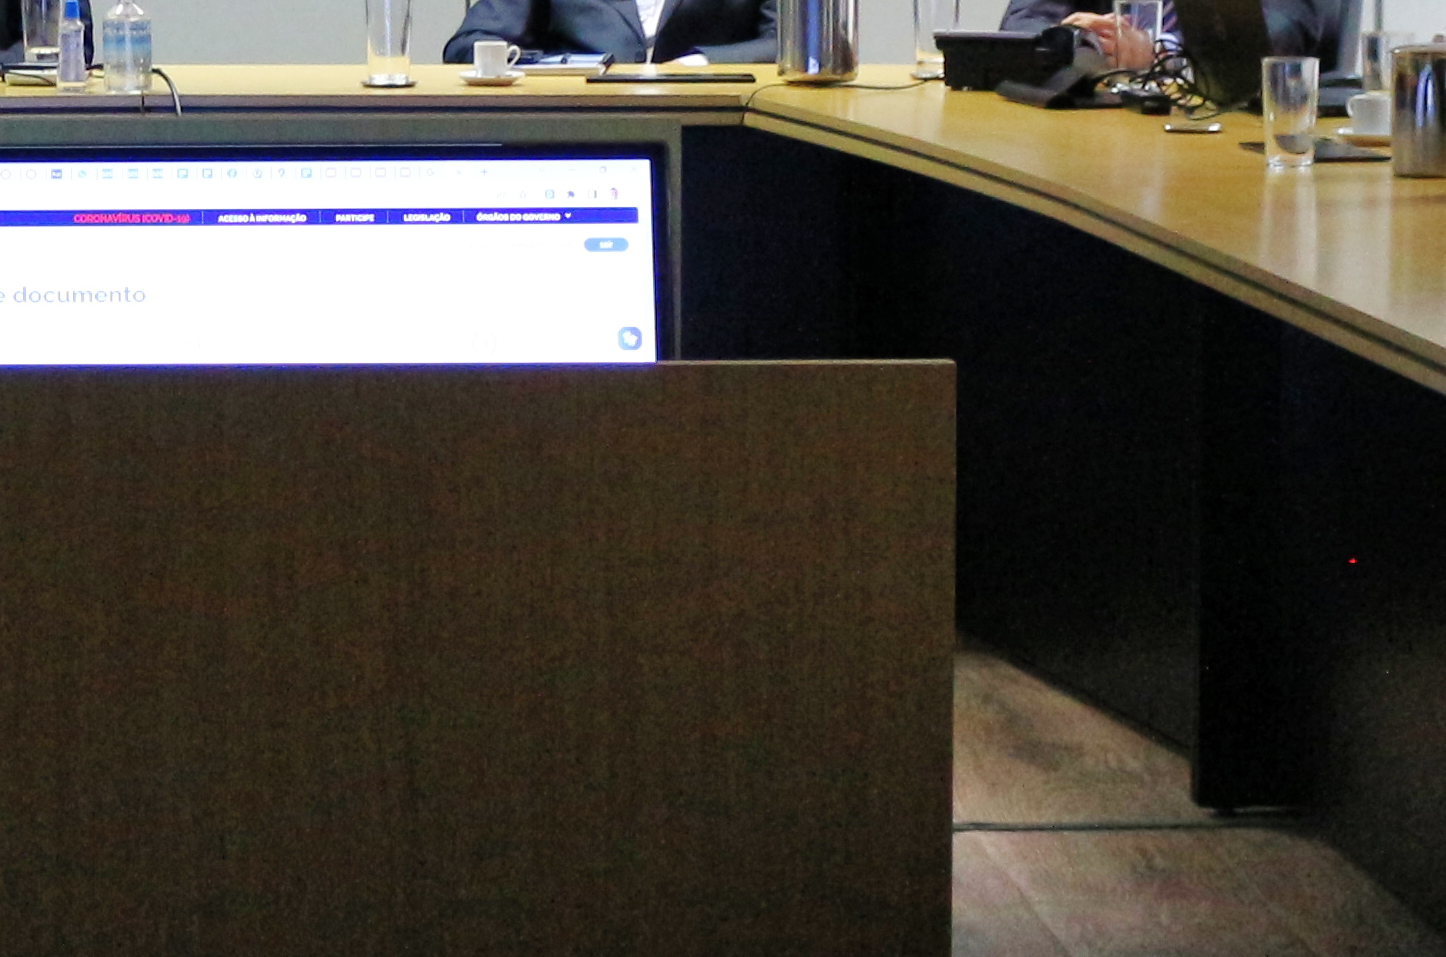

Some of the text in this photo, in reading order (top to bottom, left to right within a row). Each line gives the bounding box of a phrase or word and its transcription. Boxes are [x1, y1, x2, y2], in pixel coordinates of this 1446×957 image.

[73, 212, 191, 224] CORONAVÍRUS (COVID-19)
[218, 214, 249, 223] ACESSO
[256, 212, 307, 225] INFORMAÇÃO
[335, 213, 375, 222] PARTICIPE
[403, 212, 451, 223] LEGISLAÇÃO
[476, 211, 561, 222] ÓRGÃOS DO GOVERNO
[12, 285, 147, 304] documento
